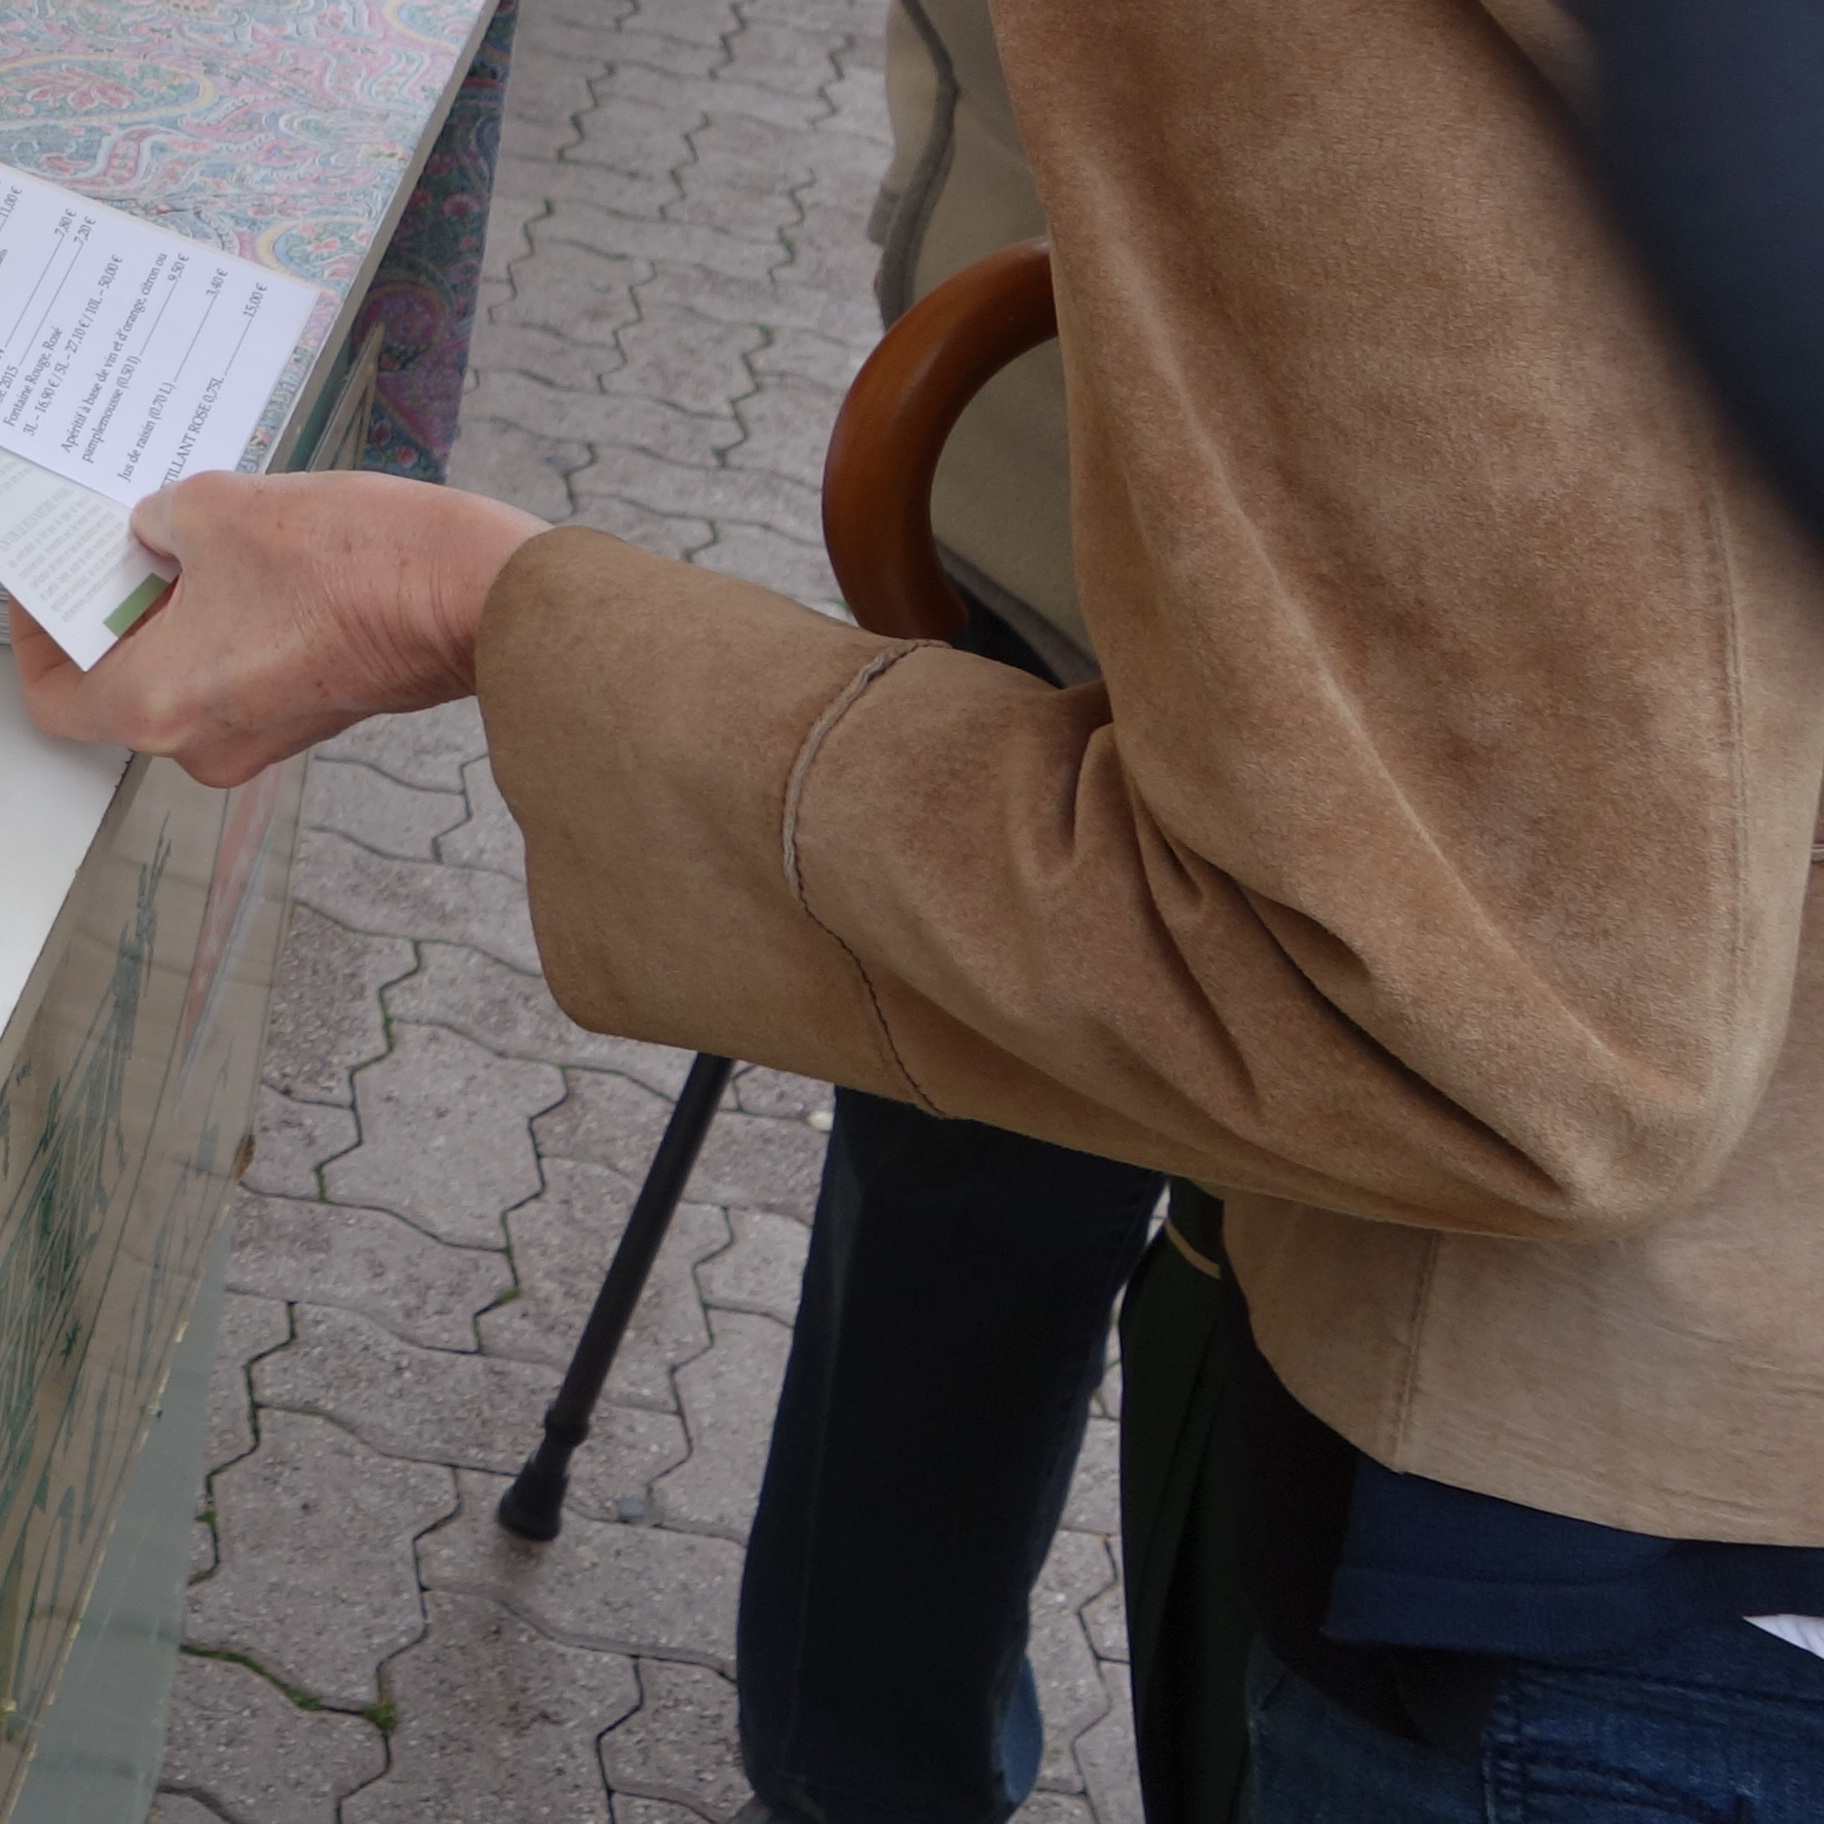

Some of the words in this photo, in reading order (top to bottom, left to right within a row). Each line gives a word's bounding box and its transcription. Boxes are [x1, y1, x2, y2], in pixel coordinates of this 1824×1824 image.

[0, 365, 18, 389] 2015
[74, 225, 91, 246] 7,20
[3, 385, 33, 427] Fontaine
[25, 353, 51, 384] Rouge,
[42, 328, 62, 350] Rosé
[23, 423, 38, 436] 3L
[35, 387, 55, 413] 16,90
[54, 362, 69, 375] 5L
[65, 328, 86, 353] 27,10
[85, 298, 102, 314] 10L
[98, 263, 118, 288] 50,00
[61, 412, 87, 453] Apéritif
[82, 383, 102, 405] base
[96, 369, 109, 382] de
[104, 353, 118, 367] vin
[114, 341, 123, 351] et
[141, 268, 160, 295] citron
[156, 253, 167, 266] ou
[82, 389, 123, 463] pamplemousse
[168, 262, 185, 282] 9,50
[117, 464, 134, 482] Jus
[127, 450, 141, 463] de
[136, 421, 155, 448] raisin
[206, 276, 224, 299] 3,40
[188, 403, 211, 433] ROSE
[243, 292, 263, 318] 15,00
